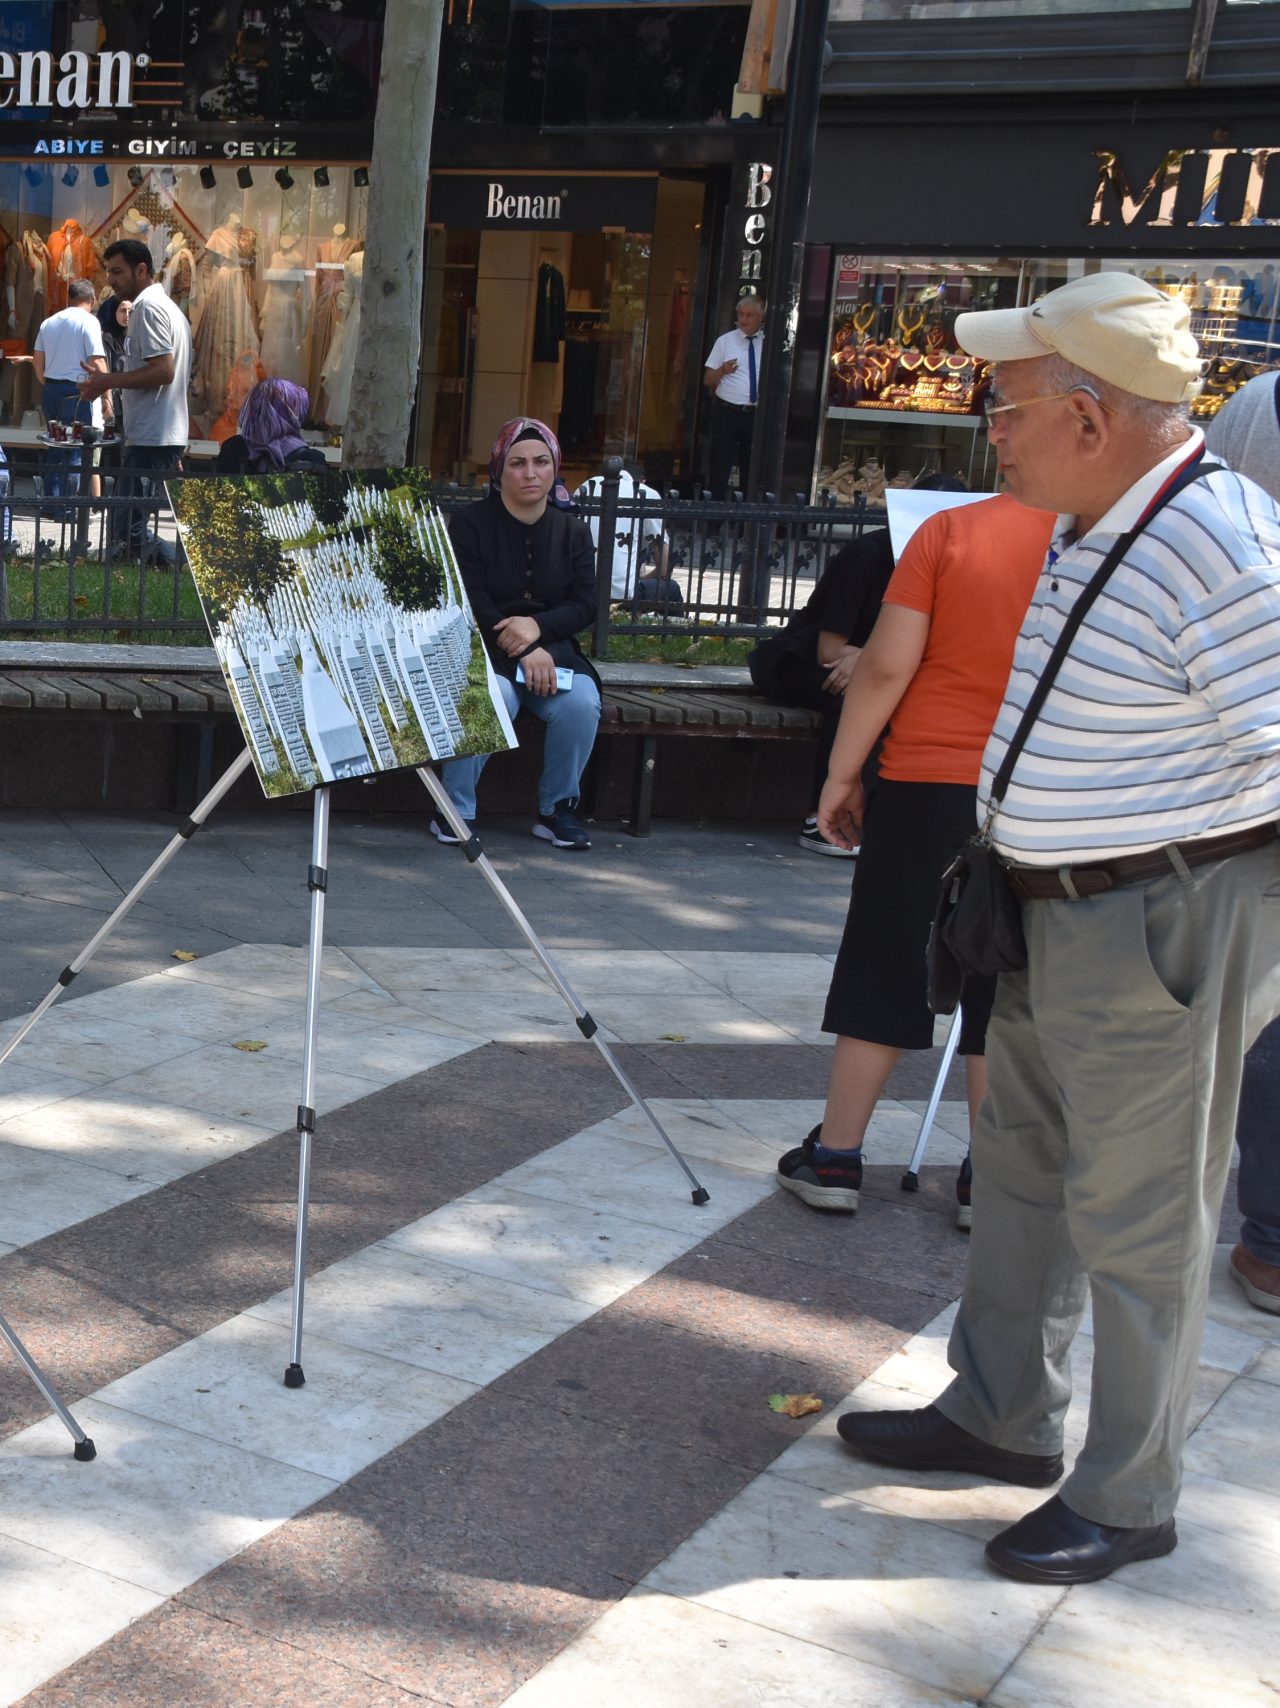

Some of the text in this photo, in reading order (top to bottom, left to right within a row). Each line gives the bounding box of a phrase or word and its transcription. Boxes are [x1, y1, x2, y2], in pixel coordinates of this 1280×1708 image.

[34, 137, 104, 154] ABİYE
[128, 136, 197, 155] GİYİM
[222, 138, 297, 159] ÇEYİZ
[486, 183, 561, 219] Benan
